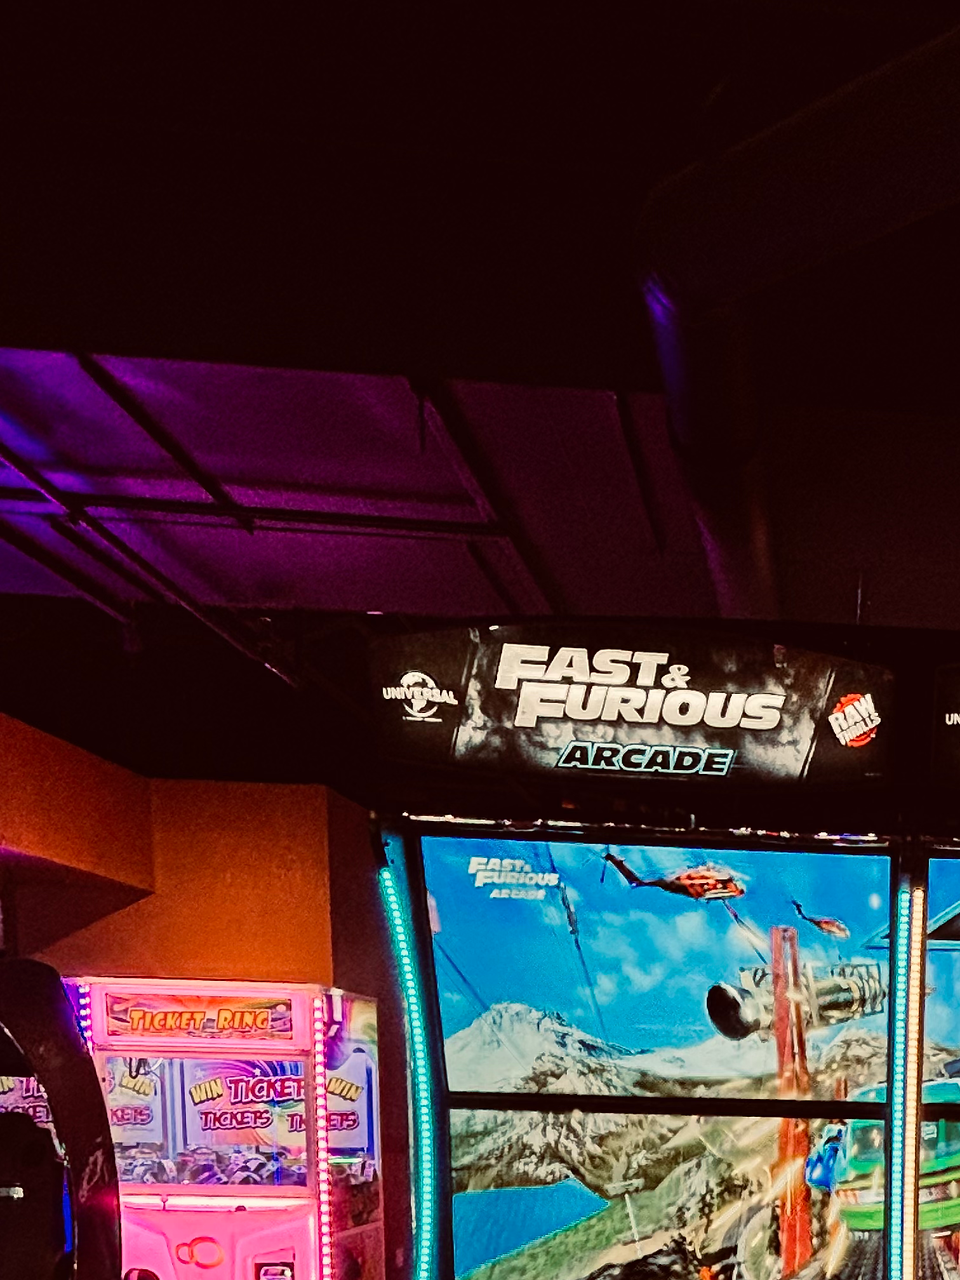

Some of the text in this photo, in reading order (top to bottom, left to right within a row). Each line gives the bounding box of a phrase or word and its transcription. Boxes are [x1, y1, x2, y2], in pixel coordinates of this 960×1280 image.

[382, 686, 459, 706] UNIVERSAL
[513, 680, 786, 730] FURIOUS
[828, 693, 876, 737] RAW
[557, 741, 736, 776] ARCADE
[474, 871, 560, 888] FURIOUS
[129, 1007, 271, 1032] TICKET RING
[189, 1075, 306, 1106] WIN TICKET
[326, 1077, 363, 1101] WIN
[200, 1109, 273, 1132] TICKETS
